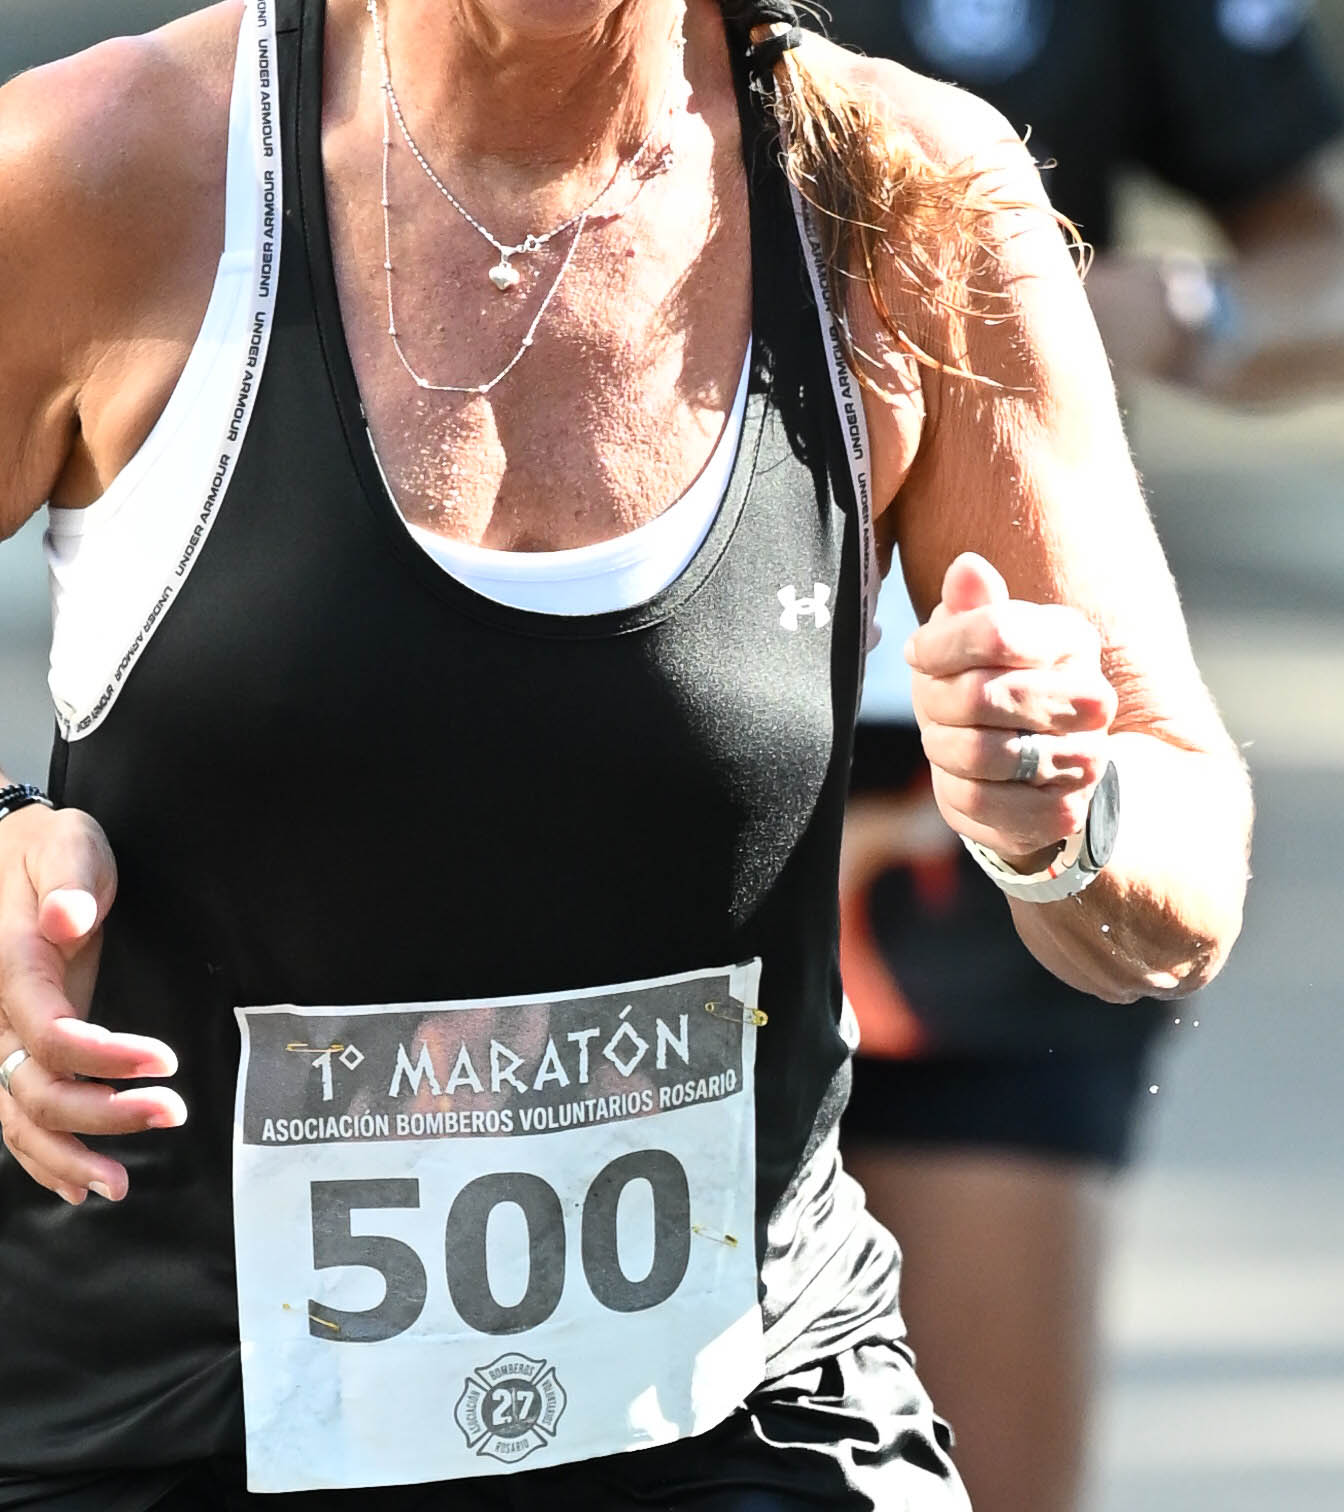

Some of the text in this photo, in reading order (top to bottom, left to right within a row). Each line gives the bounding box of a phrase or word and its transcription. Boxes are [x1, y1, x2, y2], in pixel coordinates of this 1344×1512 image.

[258, 39, 274, 157] UNDER ARMOUR
[258, 170, 275, 298] UNDER ARMOUR
[226, 311, 266, 442] UNDER ARMOUR
[843, 402, 864, 460] UNDER
[175, 453, 231, 577] UNDER ARMOUR
[857, 471, 870, 524] UNDER
[114, 585, 173, 681] UNDER ARMOUR
[388, 1004, 690, 1098] MARATÓN
[262, 1068, 737, 1142] ASOCIACIÓN BOMBEROS VOLUNTARIOS ROSARIO
[308, 1148, 691, 1343] 500
[489, 1363, 535, 1380] BOMBEROS
[492, 1388, 534, 1426] 27
[496, 1439, 530, 1454] ROSARIO
